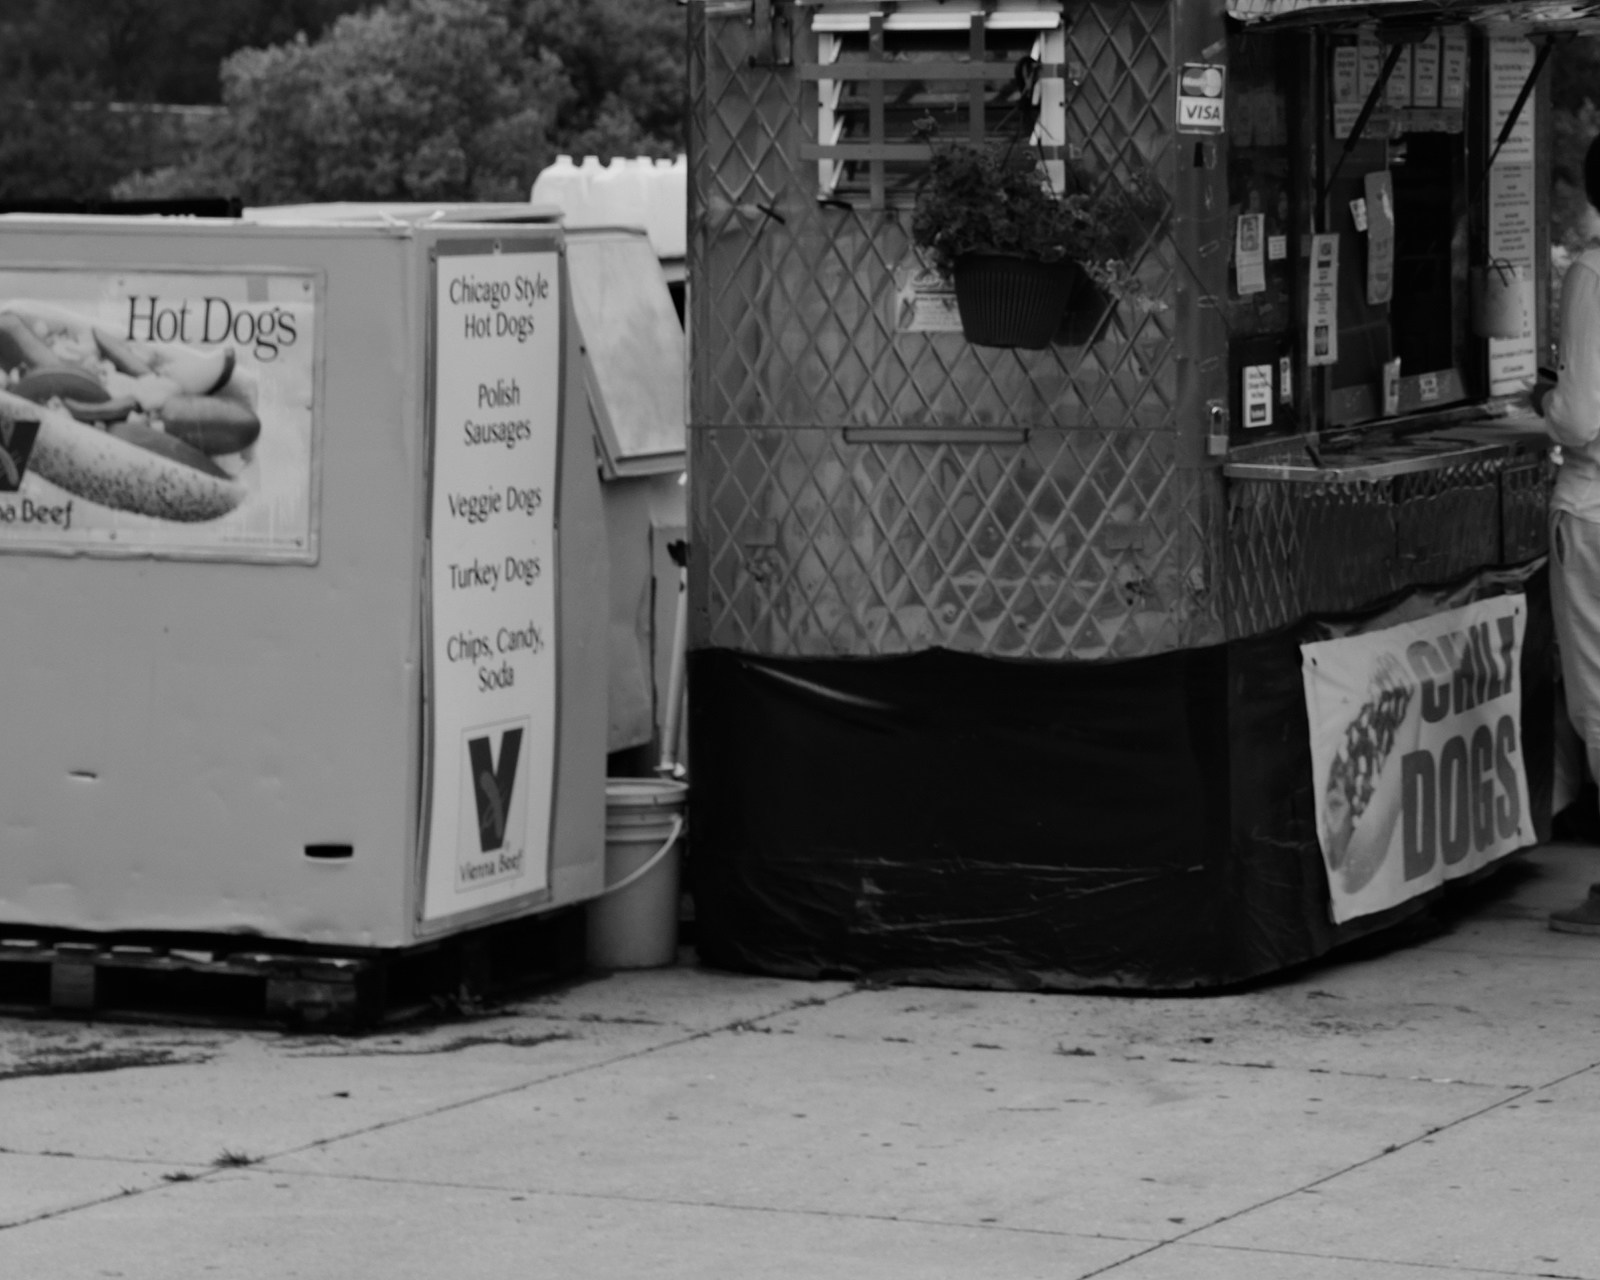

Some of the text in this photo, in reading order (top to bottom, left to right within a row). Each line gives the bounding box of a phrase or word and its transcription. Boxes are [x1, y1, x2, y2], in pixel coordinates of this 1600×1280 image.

[1186, 105, 1221, 121] VISA
[450, 271, 549, 310] Chicago Style
[126, 296, 298, 362] Hot Dogs
[465, 312, 535, 344] Hot Dogs
[478, 377, 521, 410] Polish
[464, 419, 532, 450] Sausages
[22, 498, 73, 531] Beef
[448, 485, 542, 525] Veggie Dogs
[448, 556, 541, 592] Turkey Dogs
[447, 619, 544, 664] Chips, Candy,
[478, 658, 515, 693] Soda
[1401, 715, 1520, 883] DOGS
[460, 860, 495, 883] Vienna
